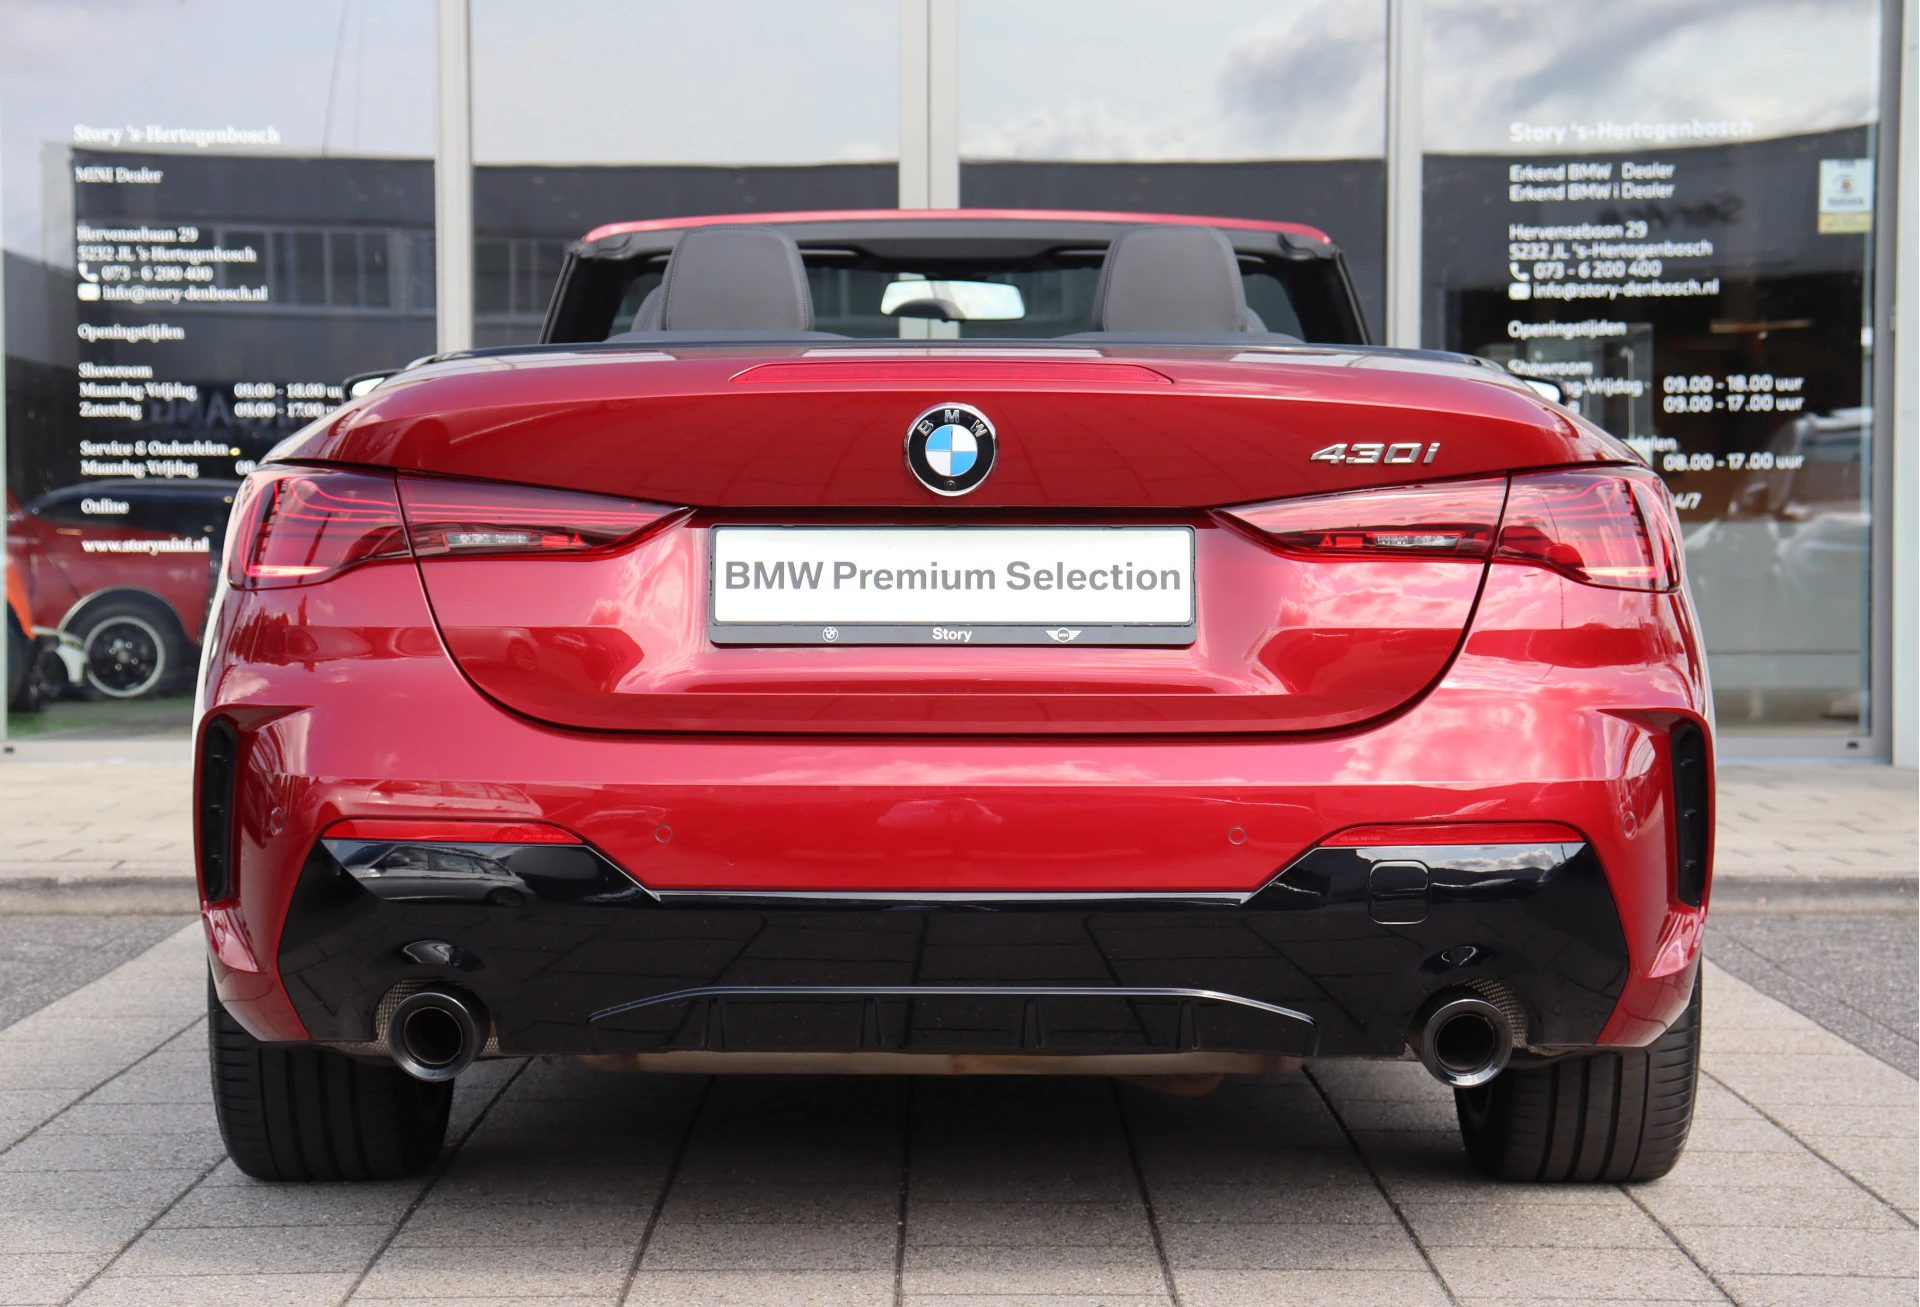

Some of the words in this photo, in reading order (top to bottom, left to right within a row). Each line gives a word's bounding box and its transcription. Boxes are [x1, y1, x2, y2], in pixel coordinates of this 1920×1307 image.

[73, 124, 122, 147] Story
[1509, 122, 1568, 144] Story
[75, 166, 113, 183] MINI
[115, 166, 163, 183] Dealer
[1509, 164, 1565, 182] Erkend
[1567, 163, 1612, 180] BMW
[1621, 161, 1676, 179] Dealer
[1509, 184, 1565, 202] Erkend
[1567, 183, 1611, 200] BMW
[1621, 181, 1676, 199] Dealer
[177, 226, 199, 243] 29
[1509, 222, 1624, 241] Hervensebaan
[1625, 220, 1648, 239] 29
[1509, 242, 1550, 260] 5232
[1550, 242, 1570, 260] JL
[101, 264, 132, 281] 073
[140, 264, 153, 281] 6
[153, 264, 184, 281] 200
[184, 264, 214, 281] 400
[1533, 261, 1565, 280] 073
[1577, 260, 1591, 279] 6
[1592, 260, 1626, 278] 200
[1628, 259, 1663, 278] 400
[102, 284, 268, 304] info@story-denbosch.nl
[1533, 277, 1720, 301] info@story-denbosch.nl
[1507, 318, 1627, 340] Openingstijden
[78, 362, 153, 378] Showroom
[1508, 358, 1593, 376] Showroom
[234, 382, 276, 399] 09.00
[286, 382, 326, 399] 18.00
[1567, 377, 1643, 398] g-Vrijdag
[1663, 375, 1714, 394] 09.00
[1726, 374, 1774, 392] 18.00
[1775, 377, 1804, 391] uur
[79, 401, 142, 421] Zaterdag
[234, 402, 276, 418] 09.00
[286, 402, 325, 418] 17.00
[1663, 395, 1714, 413] 09.00
[1726, 394, 1774, 412] 17.00
[1775, 397, 1804, 411] uur
[917, 409, 988, 438] BMW
[80, 440, 134, 456] Service
[135, 440, 147, 456] &
[148, 440, 229, 456] Onderdelen
[1310, 443, 1441, 464] 430i
[1663, 453, 1714, 471] 08.00
[1726, 452, 1774, 470] 17.00
[1775, 455, 1804, 469] uur
[81, 498, 130, 514] Online
[81, 536, 210, 556] www.storymini.nl
[725, 561, 824, 590] BMW
[833, 561, 996, 591] Premium
[1006, 560, 1181, 591] Selection
[932, 626, 972, 642] Story
